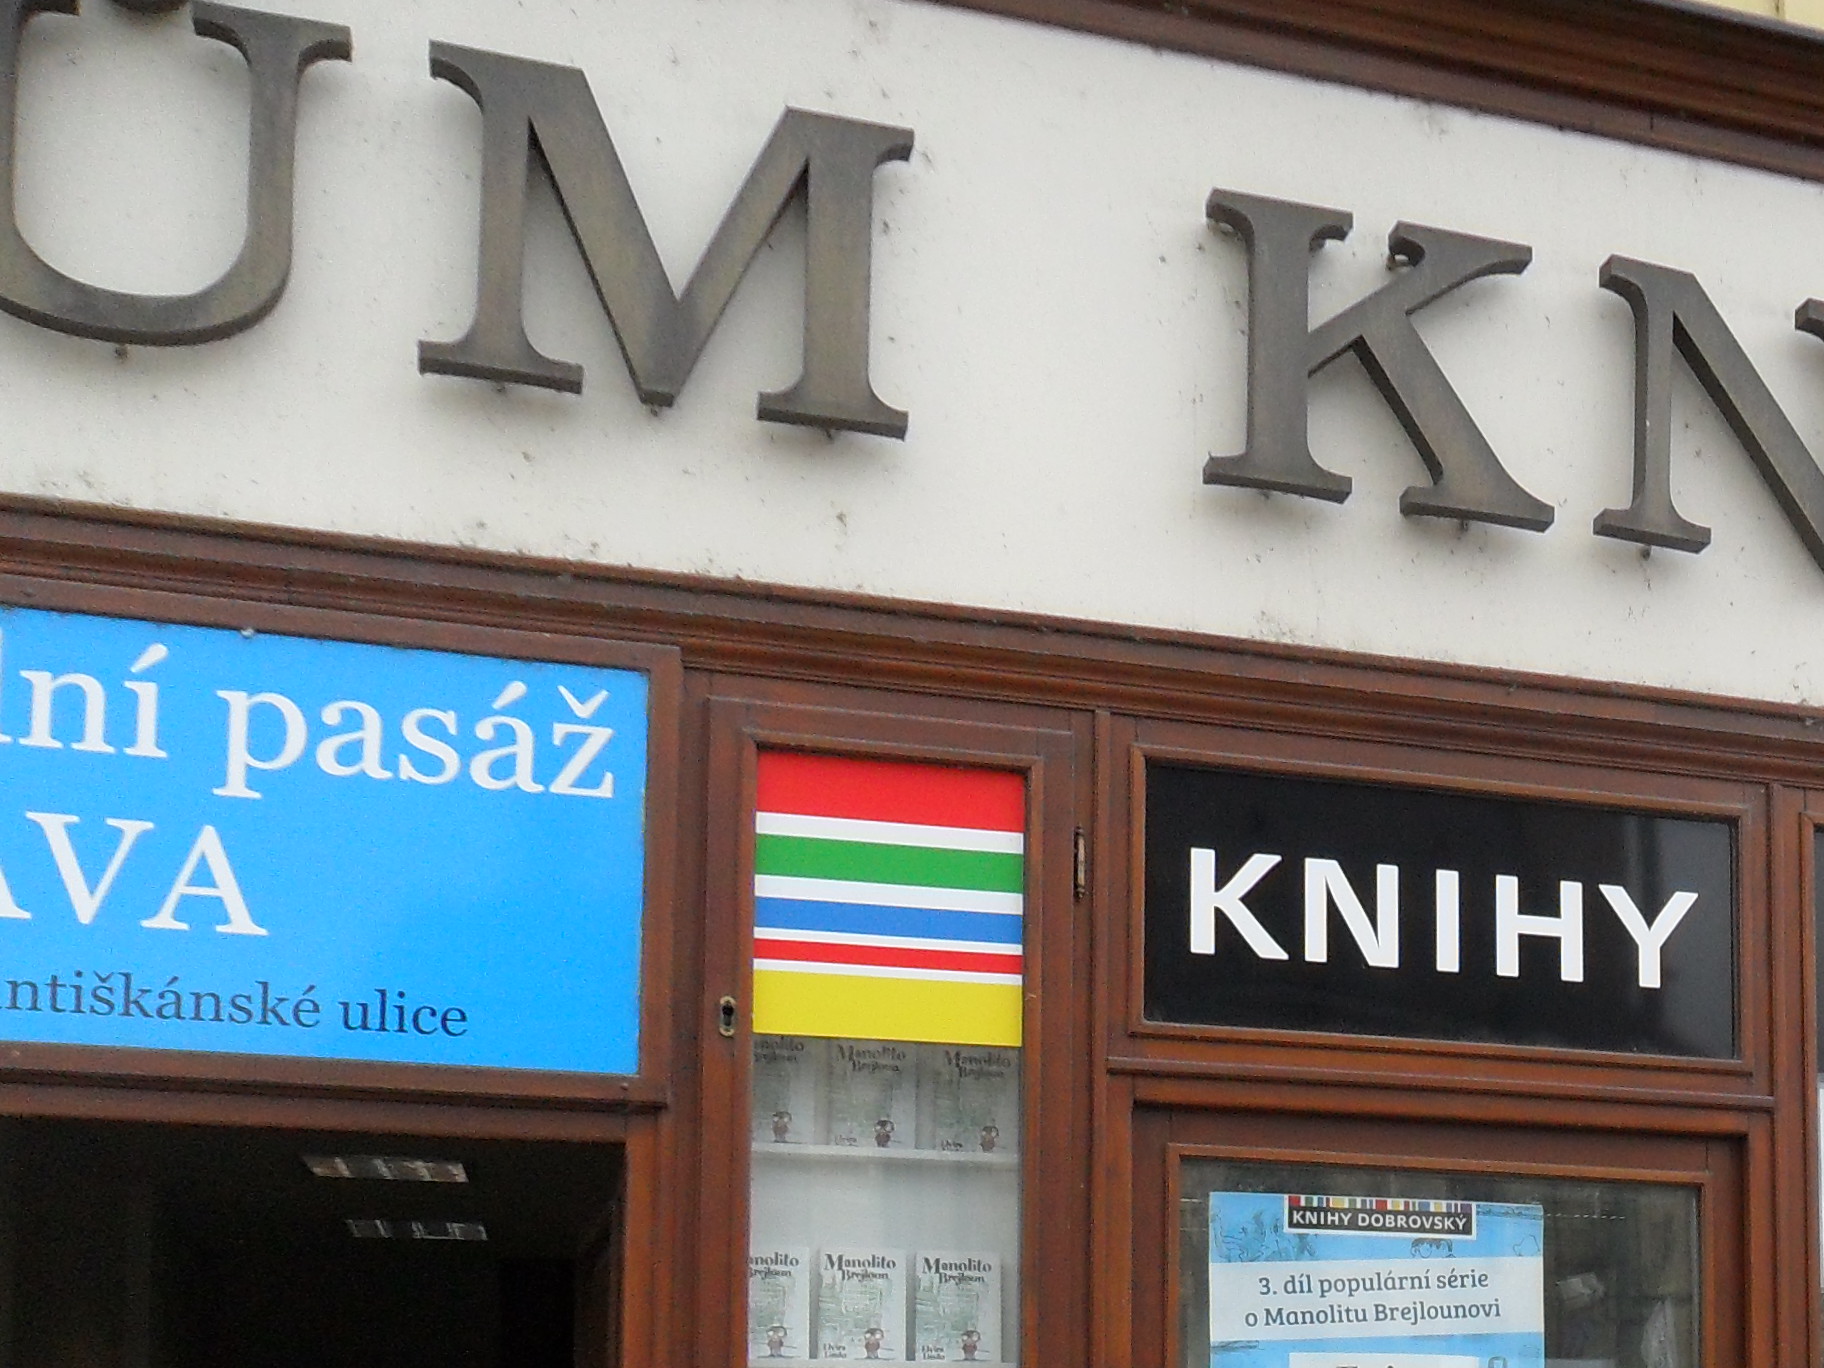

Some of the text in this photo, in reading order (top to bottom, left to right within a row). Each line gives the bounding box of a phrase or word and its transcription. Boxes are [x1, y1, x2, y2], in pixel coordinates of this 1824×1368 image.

[0, 642, 615, 799] ní pasáž
[1187, 847, 1698, 990] KNIHY
[339, 989, 469, 1038] ulice
[1292, 1209, 1468, 1232] KNIHY DOBROVSKÝ
[824, 1253, 896, 1271] Manolito
[1258, 1268, 1490, 1298] 3. díl populární série
[1244, 1297, 1502, 1328] o Manolitu Brejlounovi
